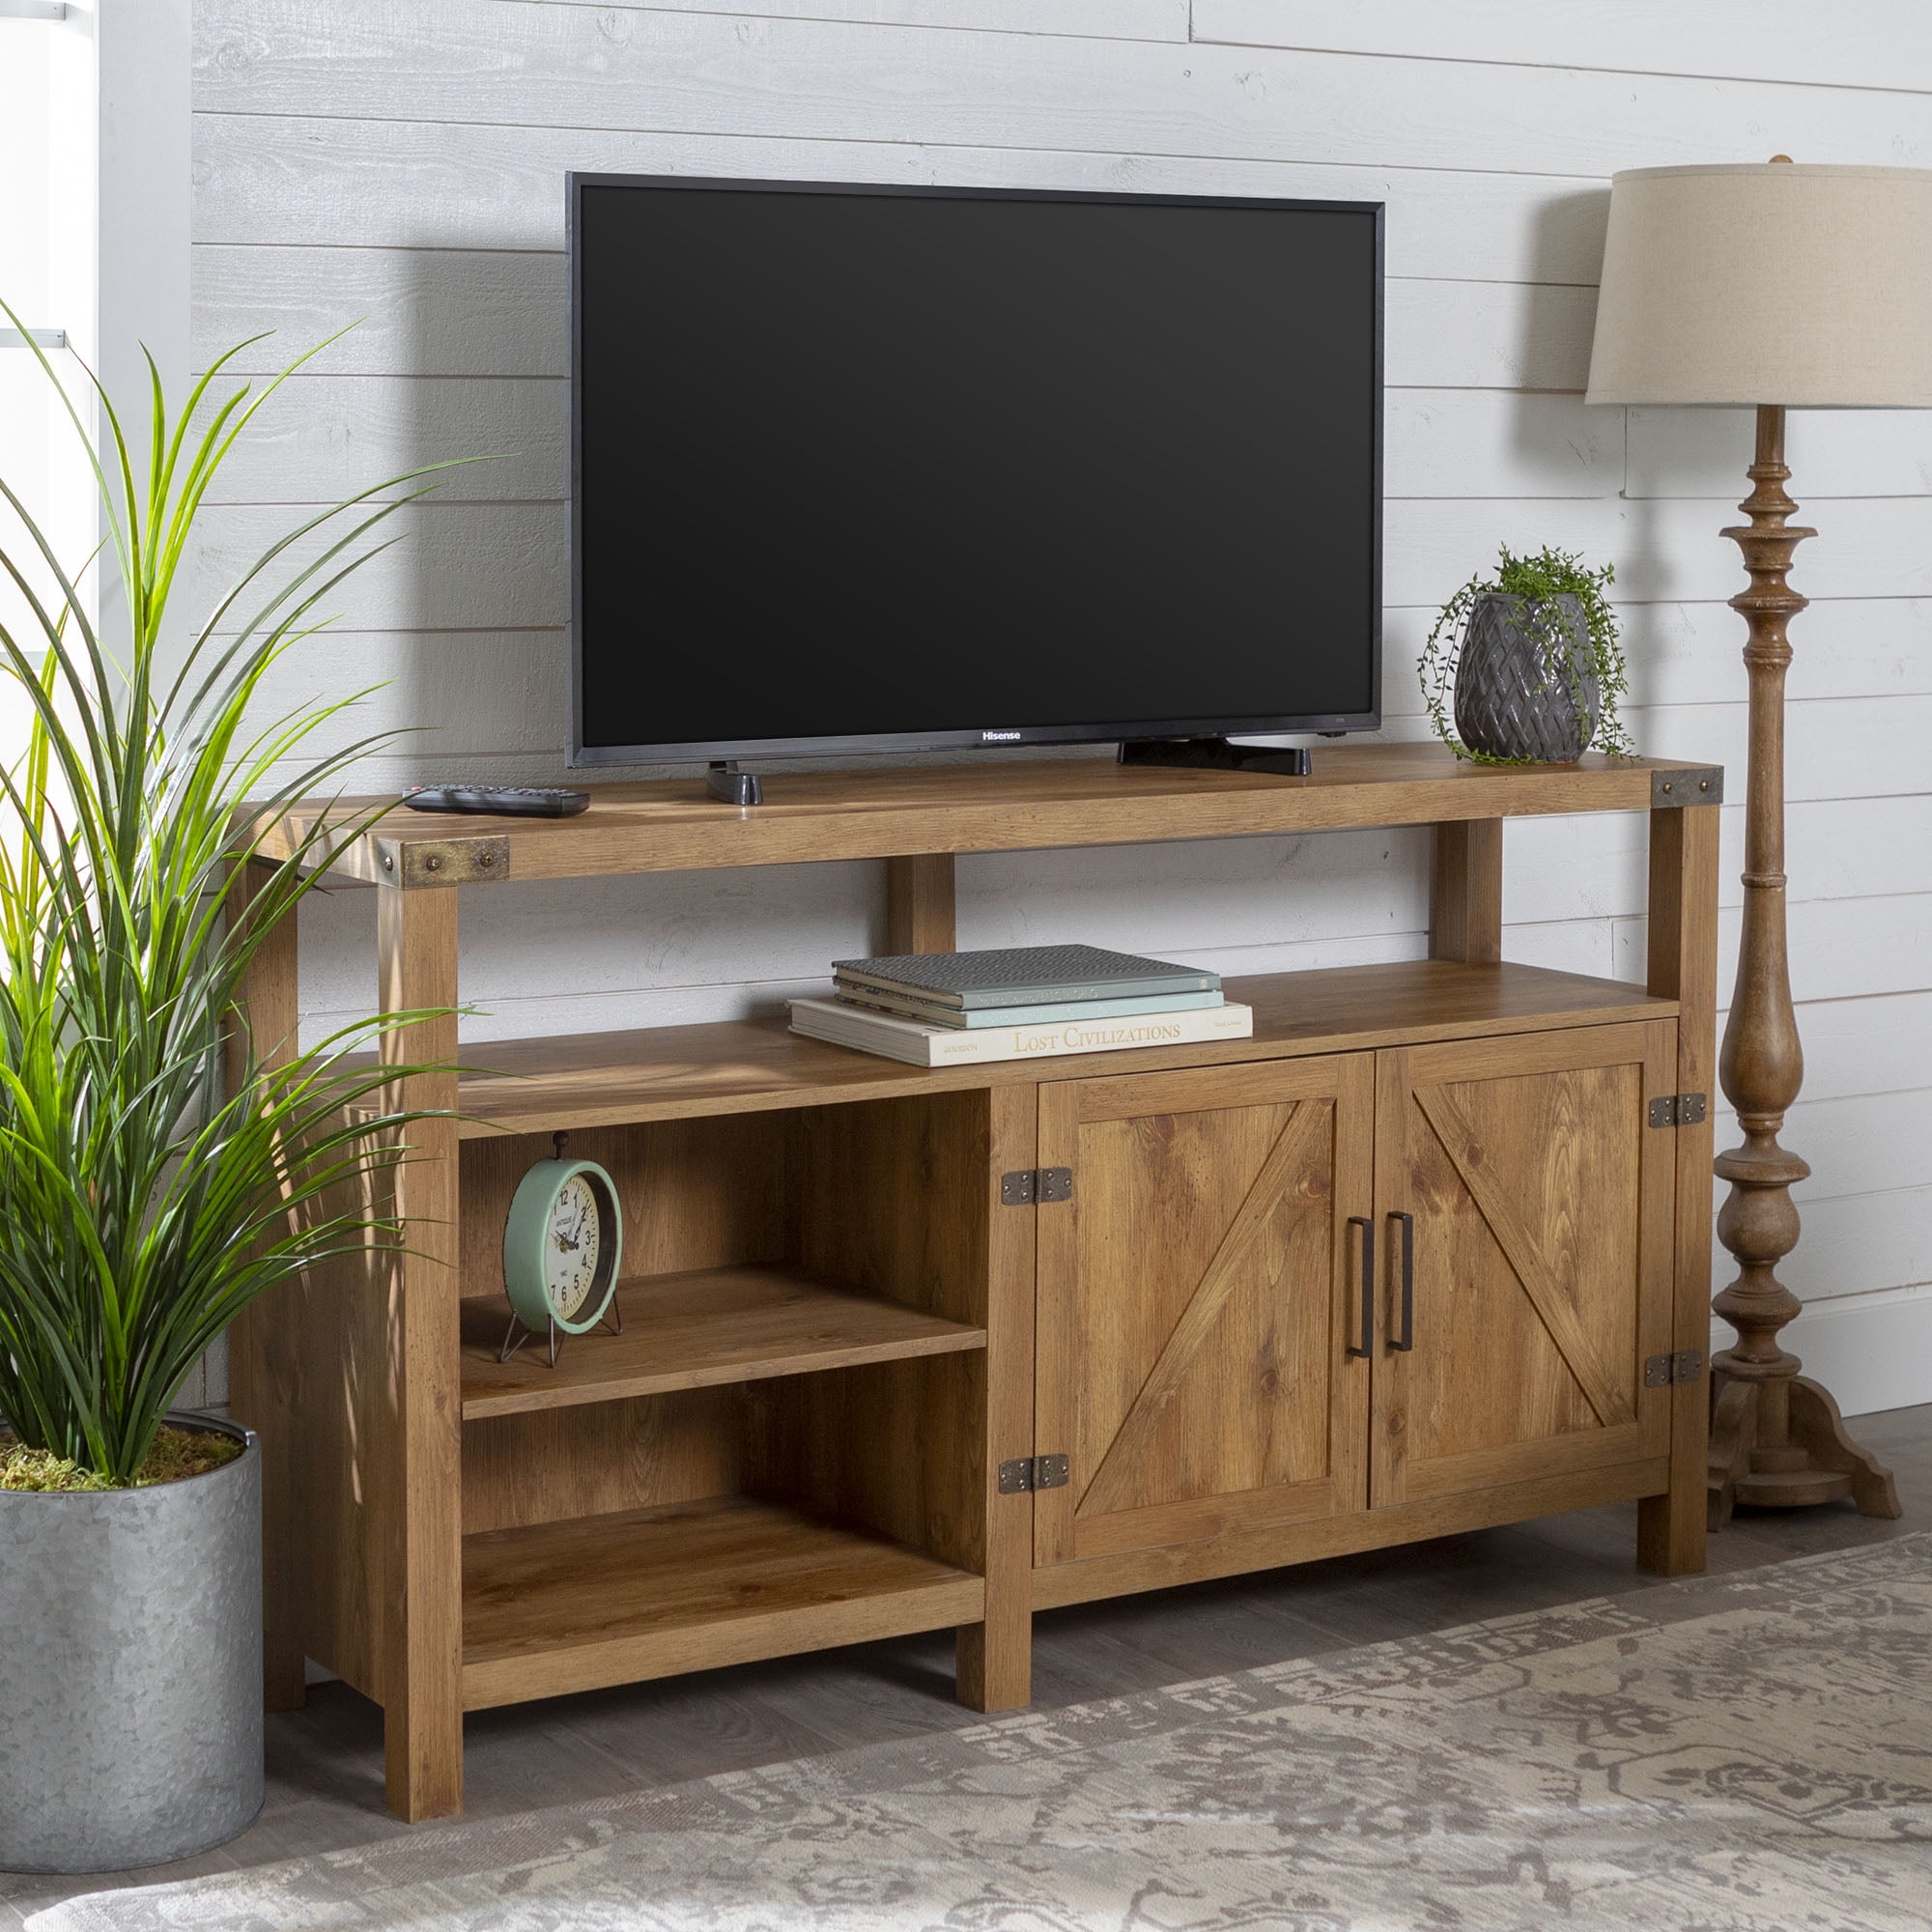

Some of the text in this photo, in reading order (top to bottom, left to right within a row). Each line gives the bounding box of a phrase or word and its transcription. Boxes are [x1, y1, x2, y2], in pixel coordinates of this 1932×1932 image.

[982, 731, 1021, 741] Hisense
[1013, 1024, 1180, 1053] LOST CIVILIZATIONS
[559, 1189, 569, 1206] 12
[573, 1193, 578, 1208] 1
[585, 1230, 591, 1246] 3
[582, 1253, 587, 1268] 4
[574, 1274, 580, 1290] 5
[551, 1284, 556, 1300] 7
[561, 1286, 567, 1301] 6
